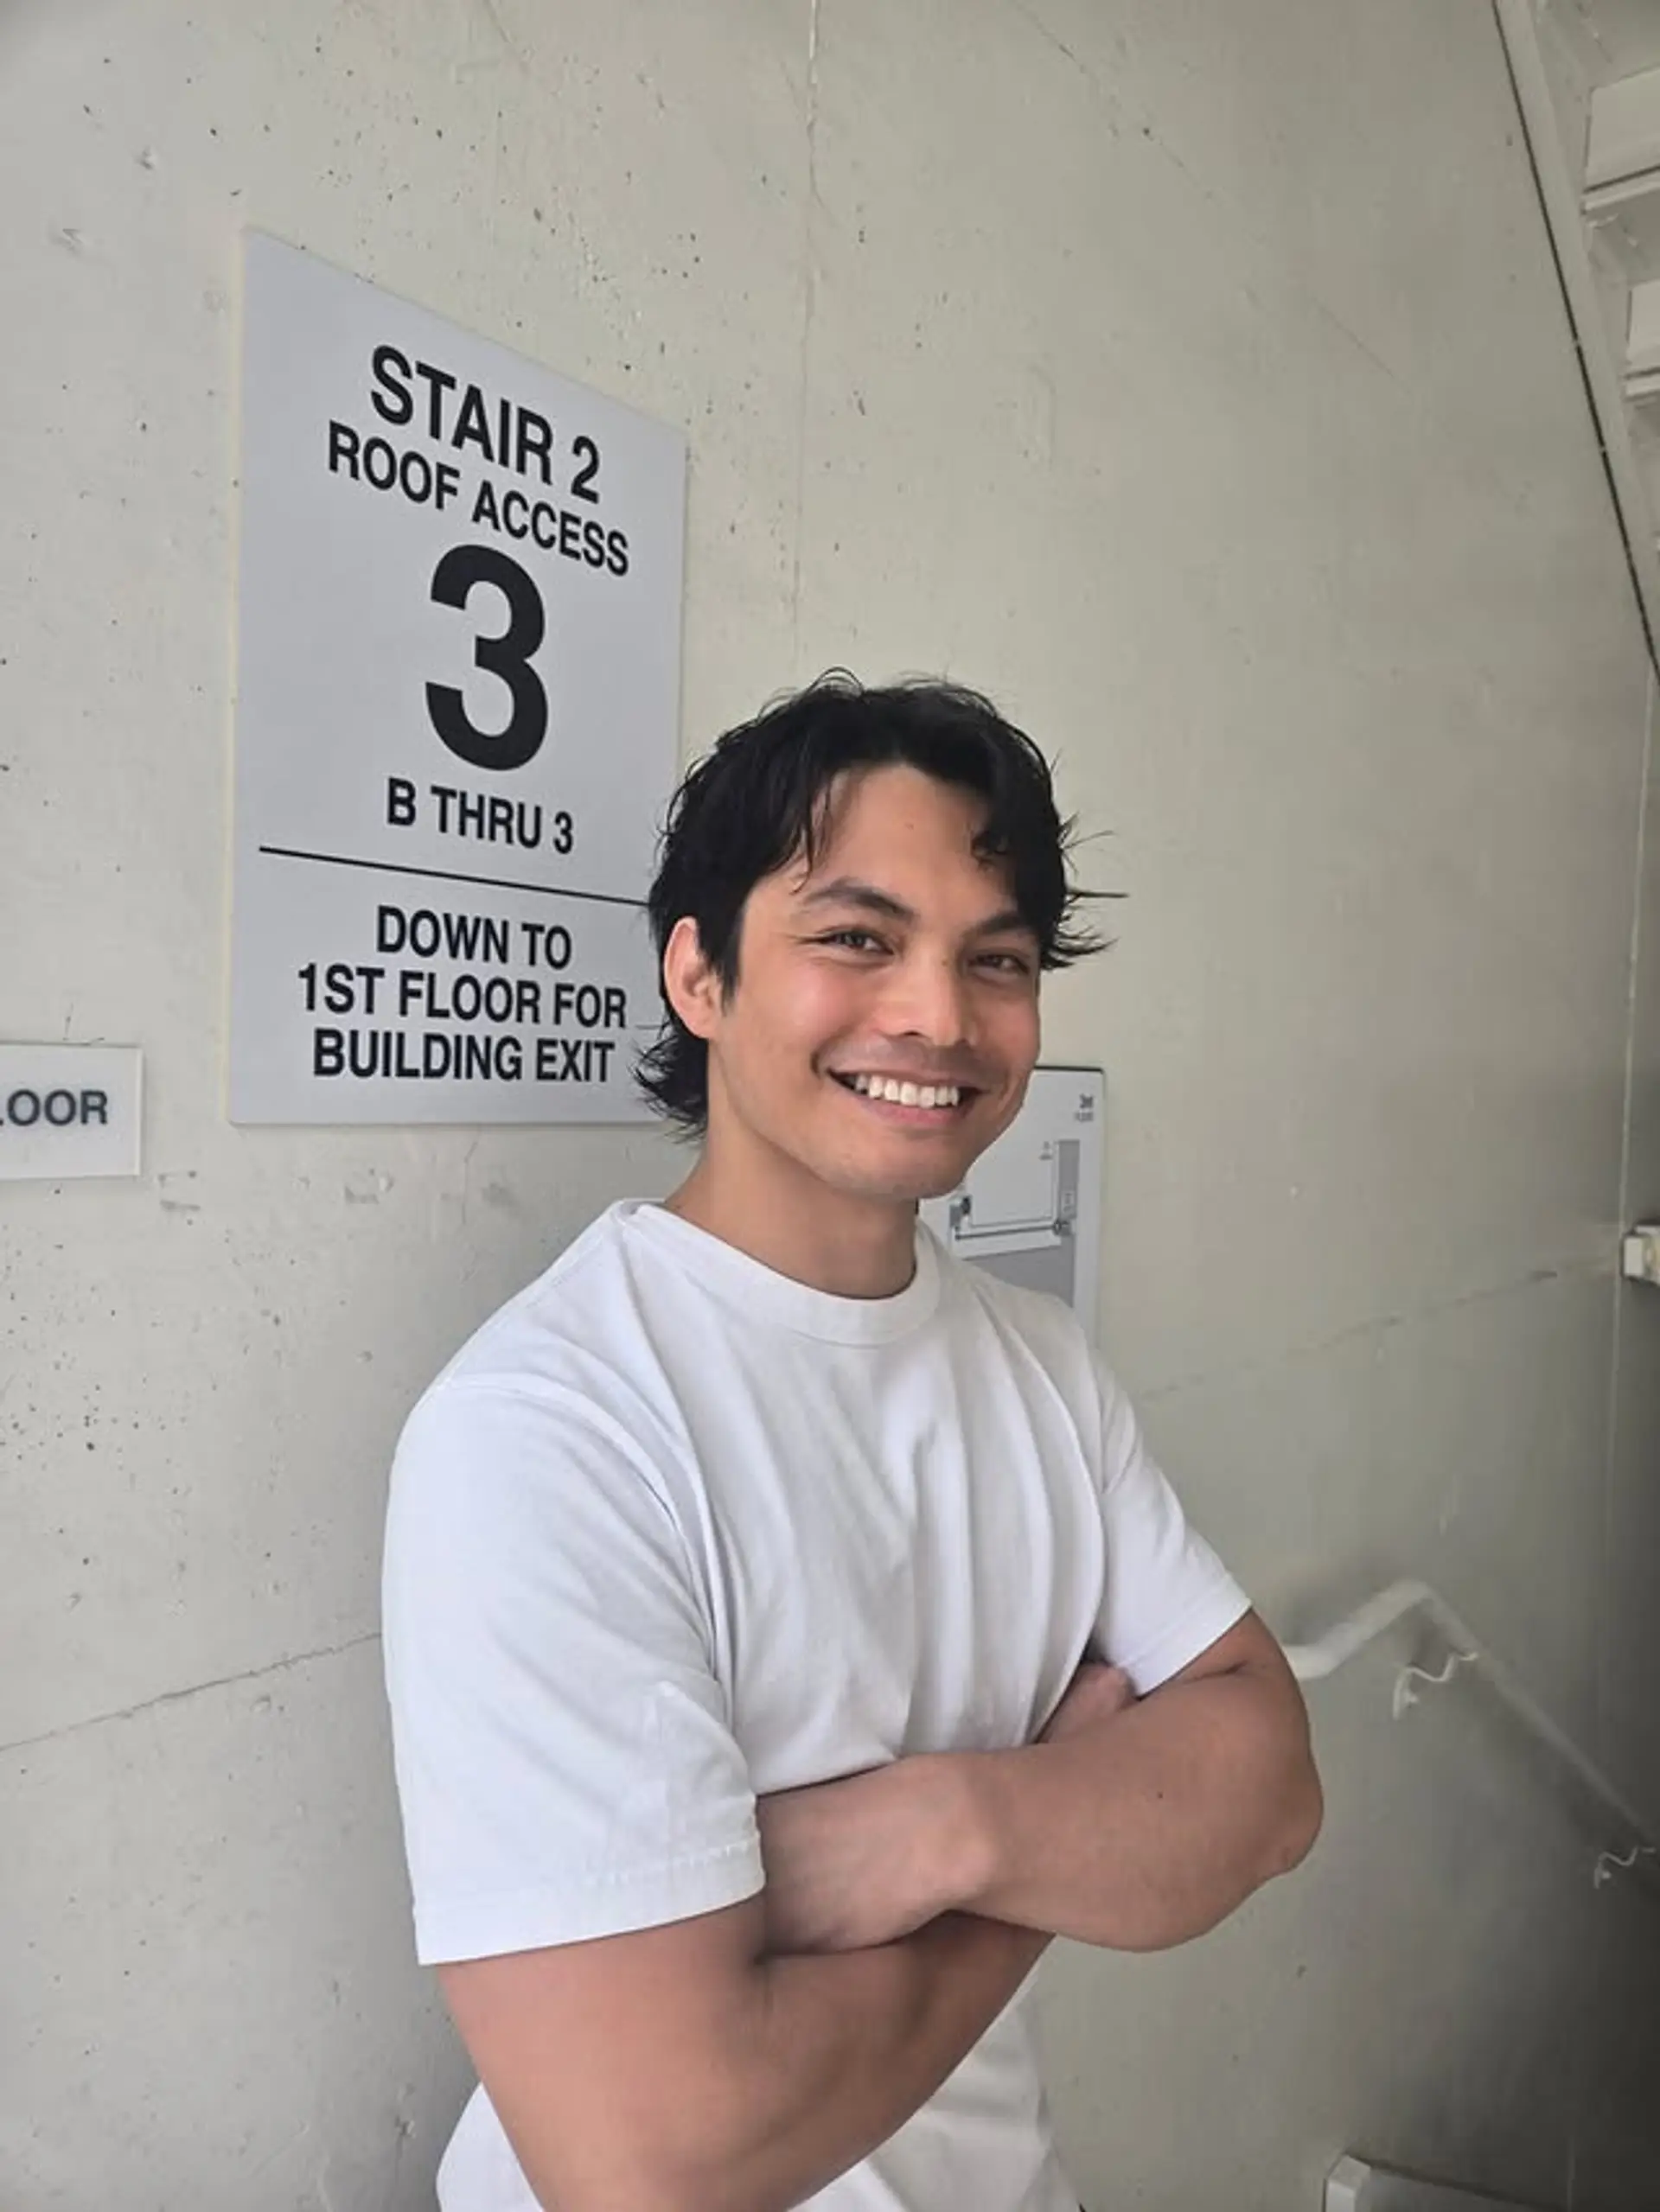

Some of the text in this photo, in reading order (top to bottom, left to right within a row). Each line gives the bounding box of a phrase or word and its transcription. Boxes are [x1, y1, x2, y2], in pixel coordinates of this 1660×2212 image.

[371, 345, 599, 504] STAIR 2
[329, 420, 629, 577] ROOF ACCESS
[425, 545, 548, 771] 3
[387, 777, 573, 855] B THRU 3
[377, 905, 571, 971] DOWN TO
[298, 963, 627, 1029] 1ST FLOOR FOR
[314, 1028, 616, 1083] BUILDING EXIT
[0, 1089, 108, 1127] OOR
